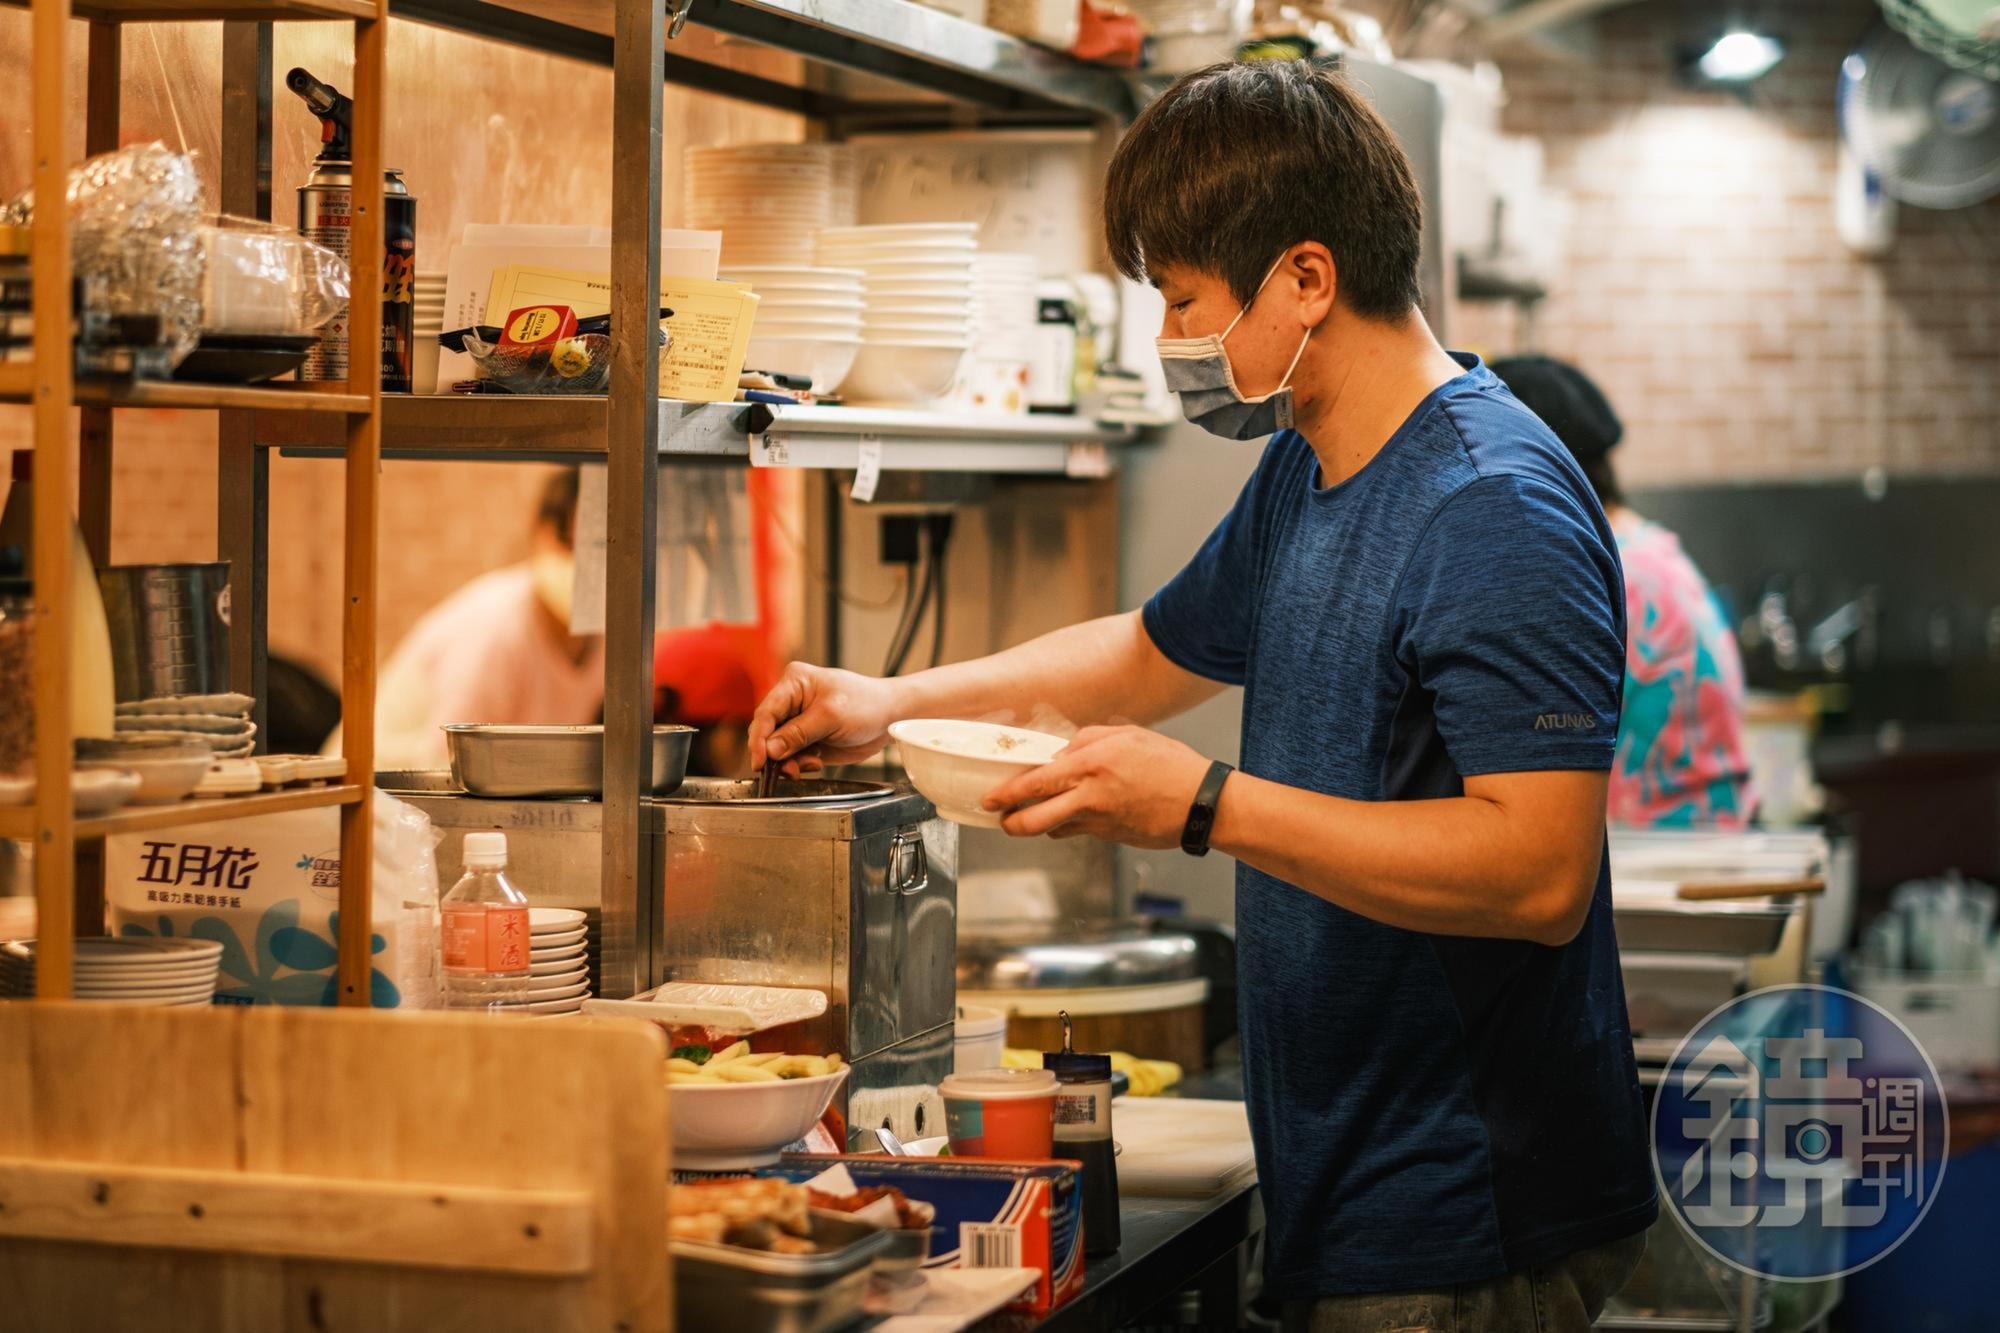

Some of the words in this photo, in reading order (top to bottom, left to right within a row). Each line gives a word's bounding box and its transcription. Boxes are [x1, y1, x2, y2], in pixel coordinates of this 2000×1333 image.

[1534, 713, 1596, 729] ATUNAS
[136, 841, 260, 890] 五月花
[501, 913, 521, 967] 米酒
